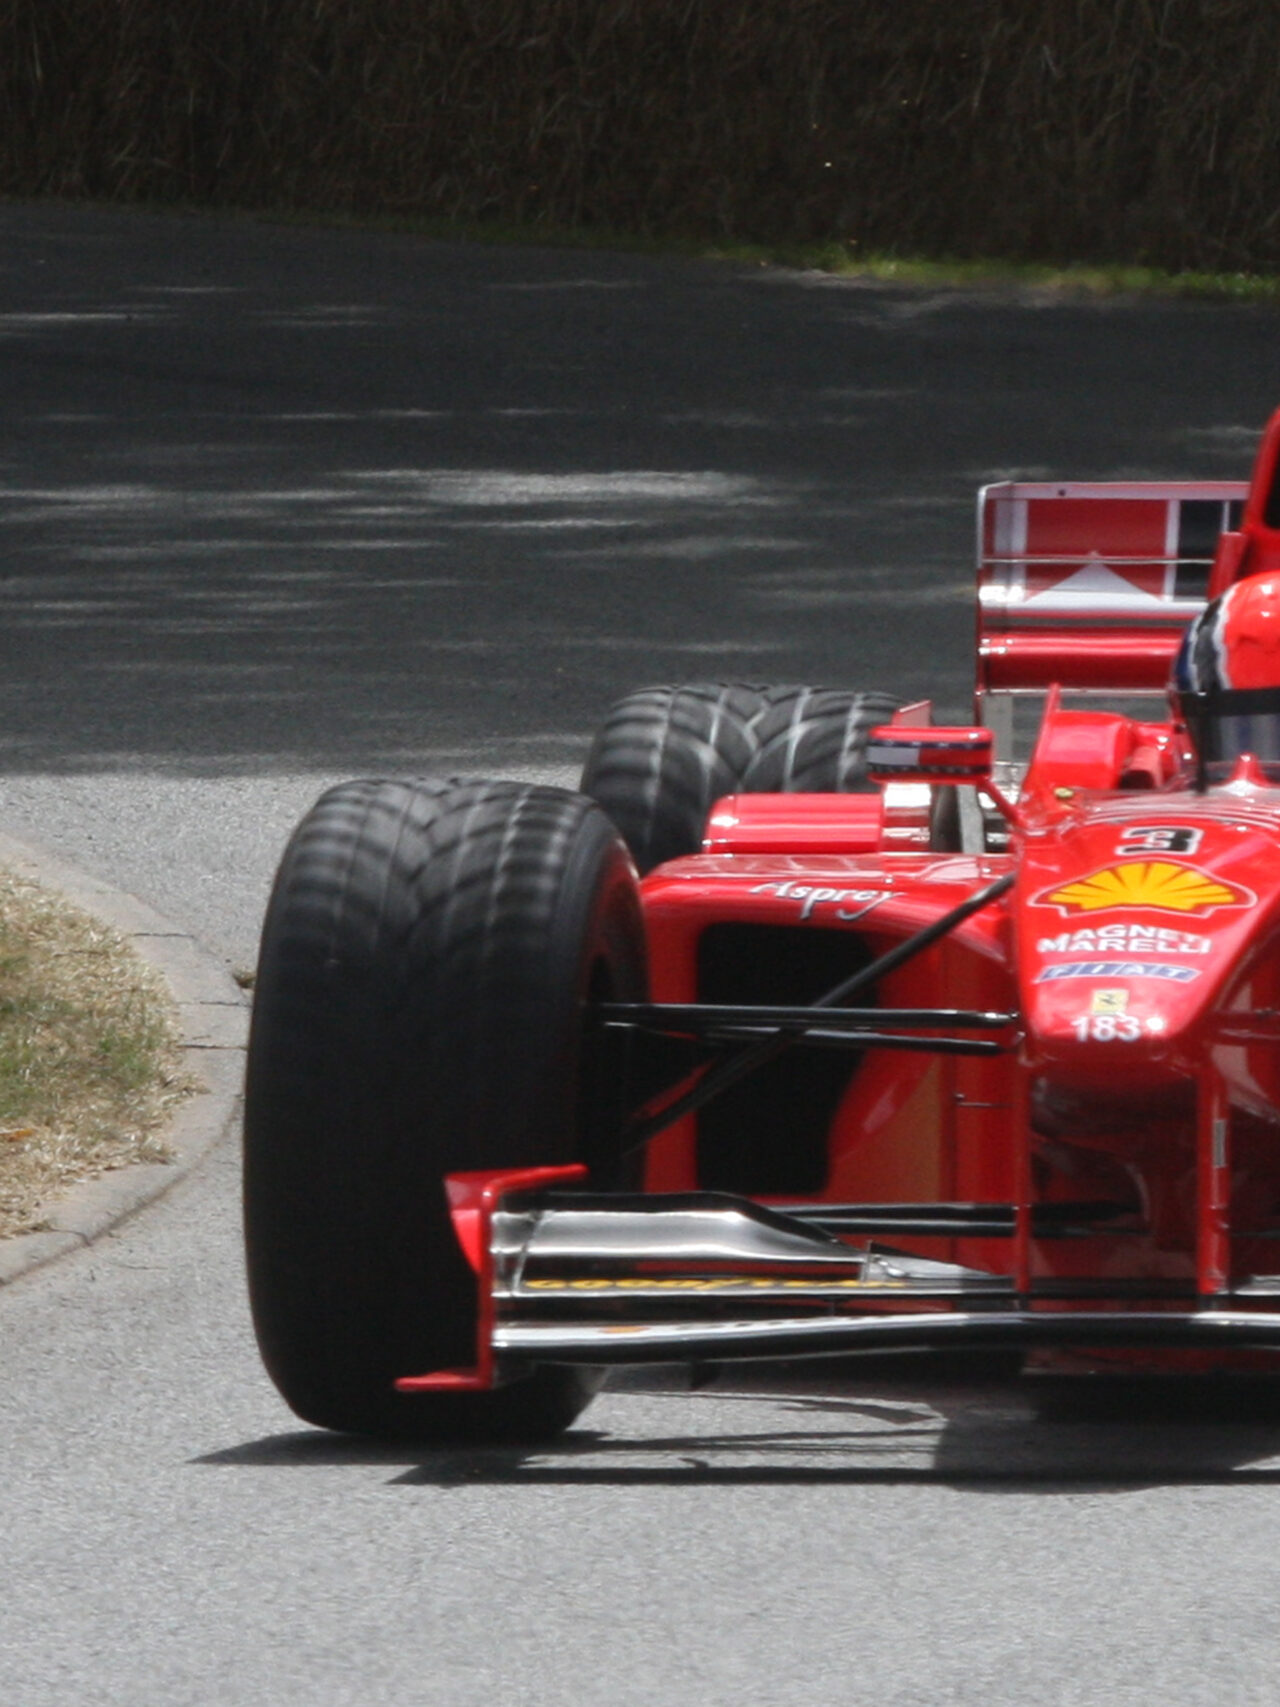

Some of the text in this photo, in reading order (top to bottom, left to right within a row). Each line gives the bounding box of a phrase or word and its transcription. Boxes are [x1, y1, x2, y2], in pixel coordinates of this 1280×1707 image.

[1114, 826, 1204, 856] 3
[750, 881, 906, 920] Asprey
[1036, 924, 1211, 947] MAGNETI
[1036, 935, 1211, 953] MARELLI
[1048, 963, 1188, 980] FIAT
[1071, 1015, 1141, 1042] 183
